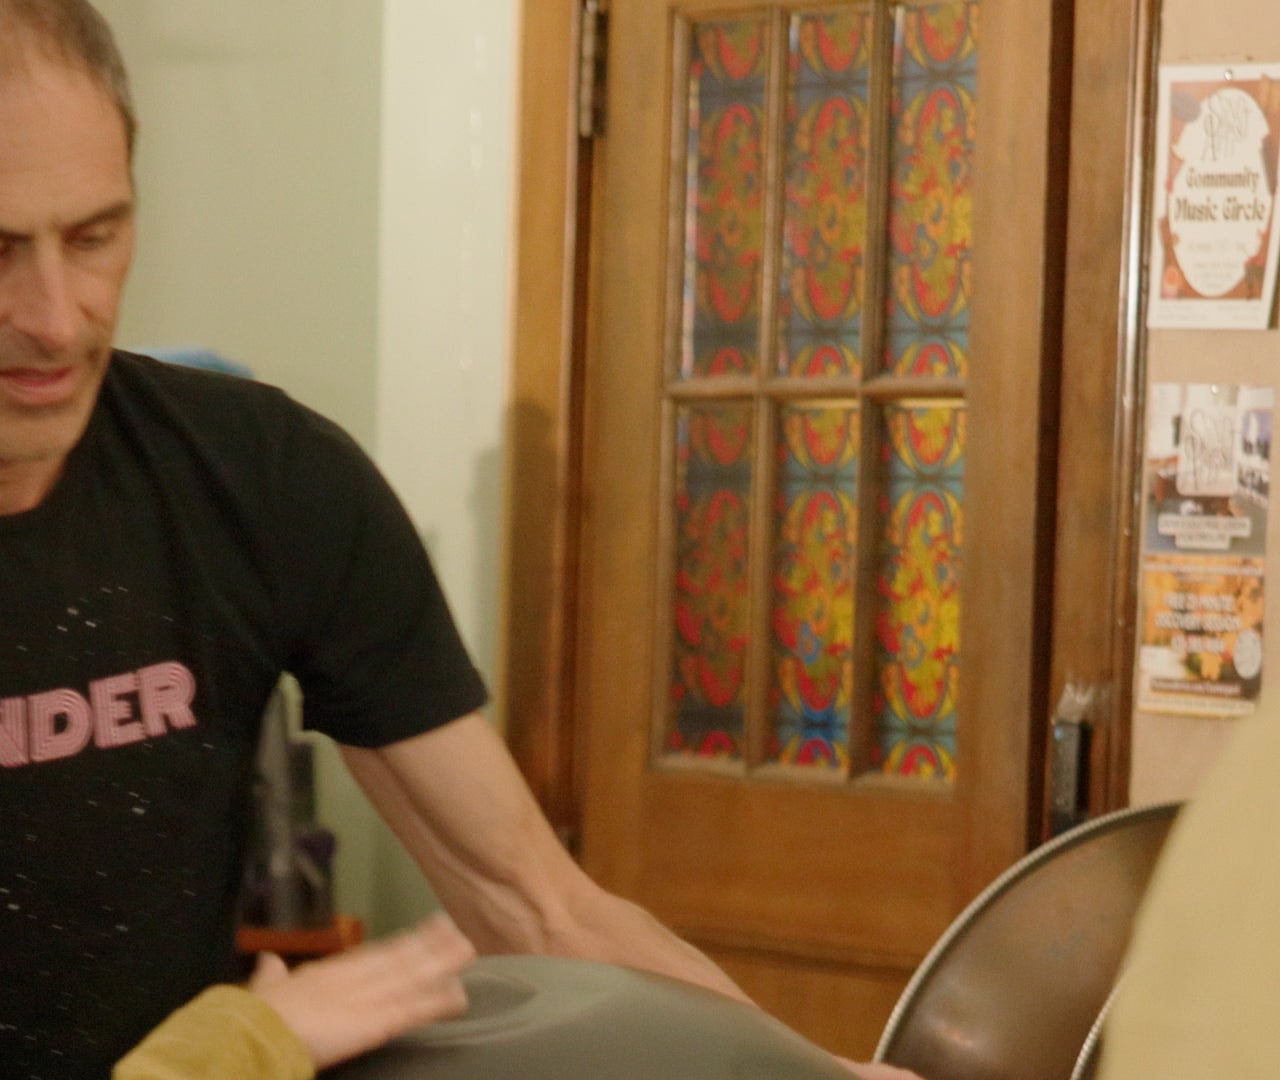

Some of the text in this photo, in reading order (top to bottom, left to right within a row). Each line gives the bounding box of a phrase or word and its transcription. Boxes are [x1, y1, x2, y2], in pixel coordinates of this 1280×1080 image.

[1185, 166, 1260, 193] Community
[1174, 195, 1266, 222] Music Circle
